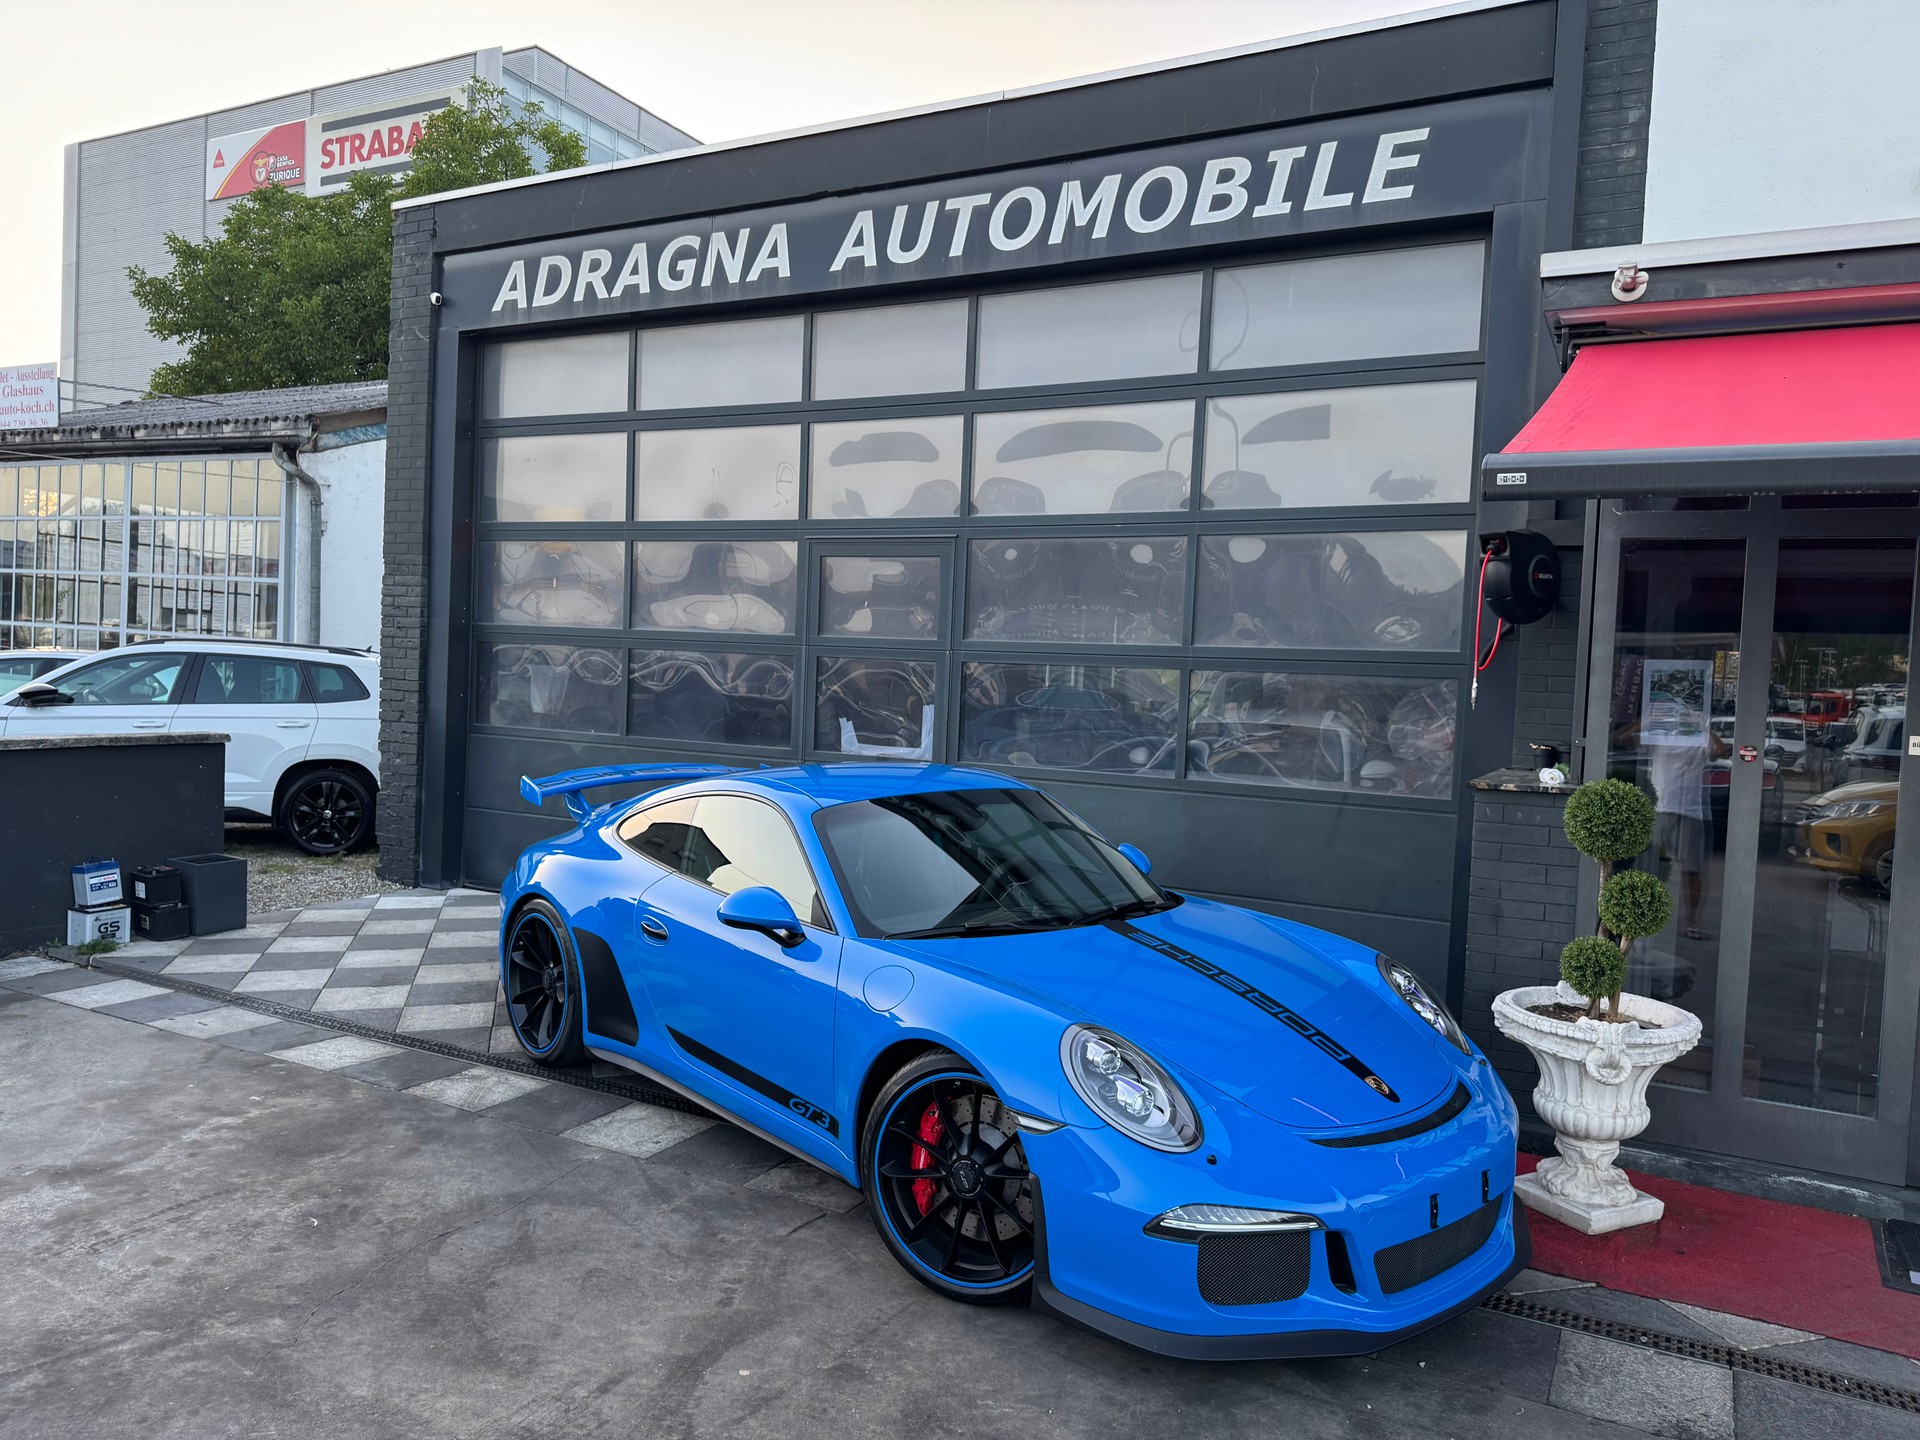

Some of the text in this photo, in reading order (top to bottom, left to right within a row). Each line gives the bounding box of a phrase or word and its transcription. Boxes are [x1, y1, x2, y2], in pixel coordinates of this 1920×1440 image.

[320, 121, 433, 169] STRABA
[269, 167, 301, 183] ZURIQUE
[491, 127, 1431, 312] ADRAGNA AUTOMOBILE
[16, 368, 55, 382] Ausstellung
[2, 384, 44, 398] Glashaus
[0, 400, 55, 415] auto-koch.ch
[13, 419, 26, 427] 730
[40, 418, 49, 426] 36
[98, 920, 120, 934] GS
[1128, 931, 1351, 1061] PORSCHE
[789, 1097, 831, 1129] GT3
